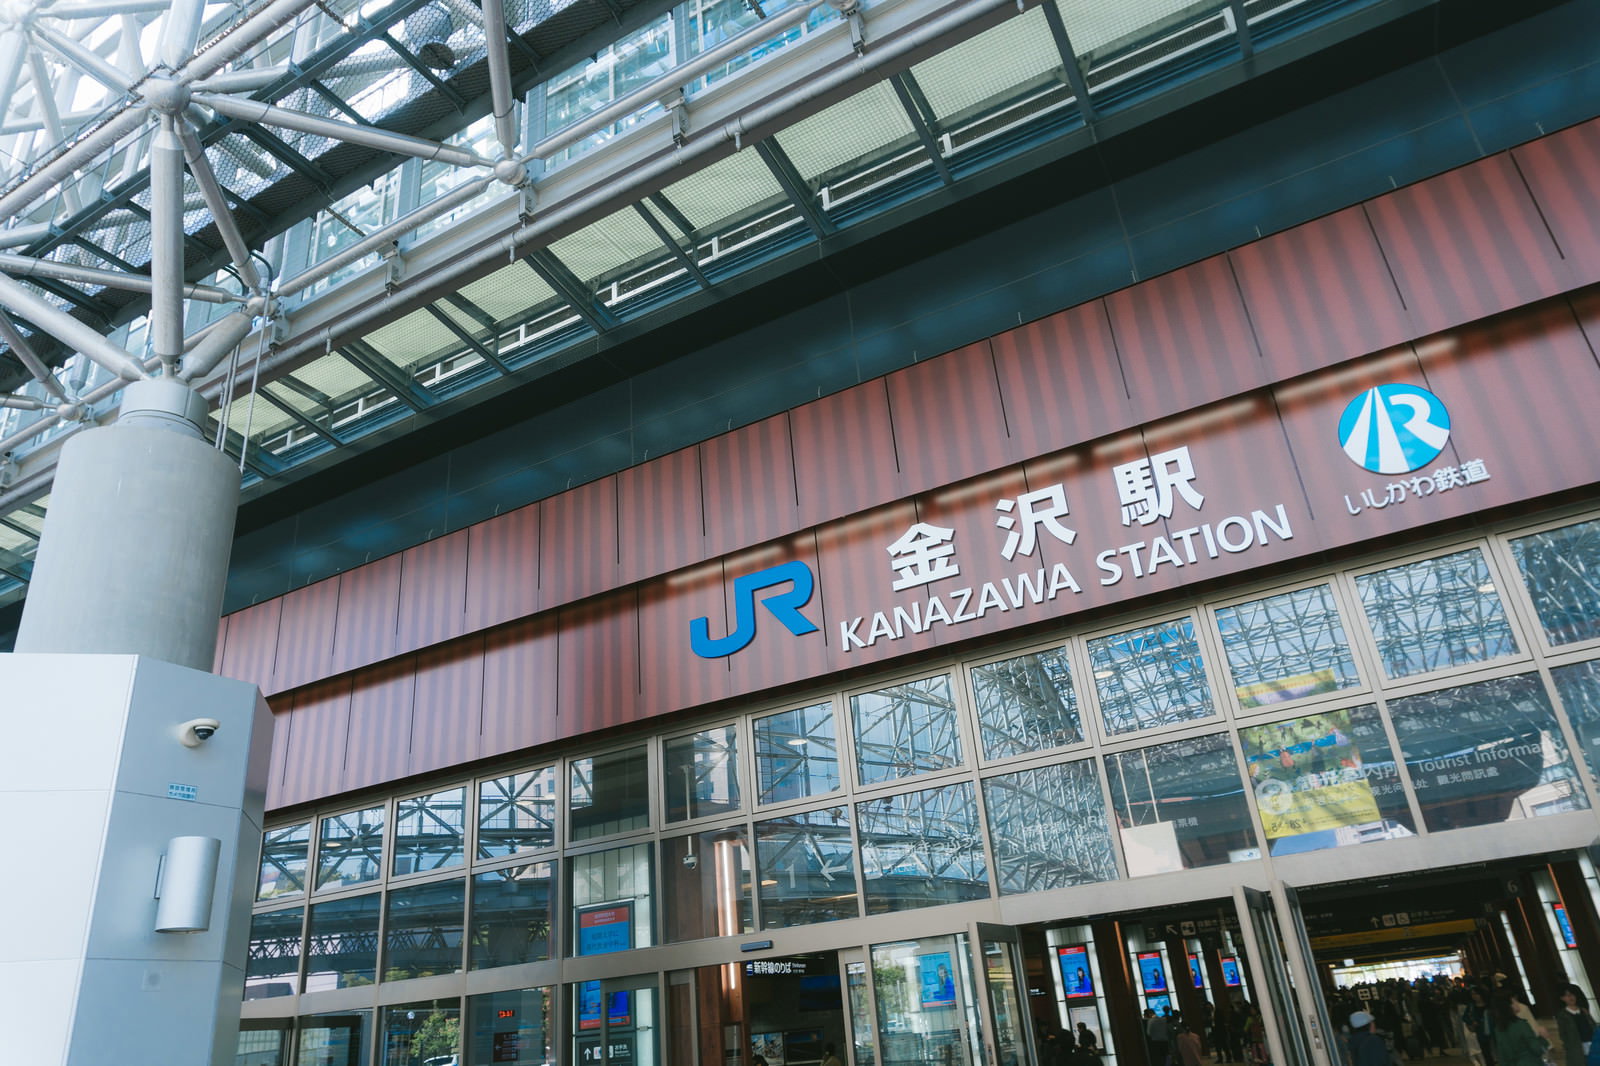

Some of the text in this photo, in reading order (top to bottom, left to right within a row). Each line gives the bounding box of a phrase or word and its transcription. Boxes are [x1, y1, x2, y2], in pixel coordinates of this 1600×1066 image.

[1344, 458, 1491, 515] いしかわ鉄道
[886, 446, 1204, 592] 金沢駅
[840, 503, 1293, 652] KANAZAWA STATION
[690, 560, 819, 659] JR
[1417, 753, 1471, 773] Tourist
[785, 863, 797, 889] 1
[1507, 880, 1519, 893] 6
